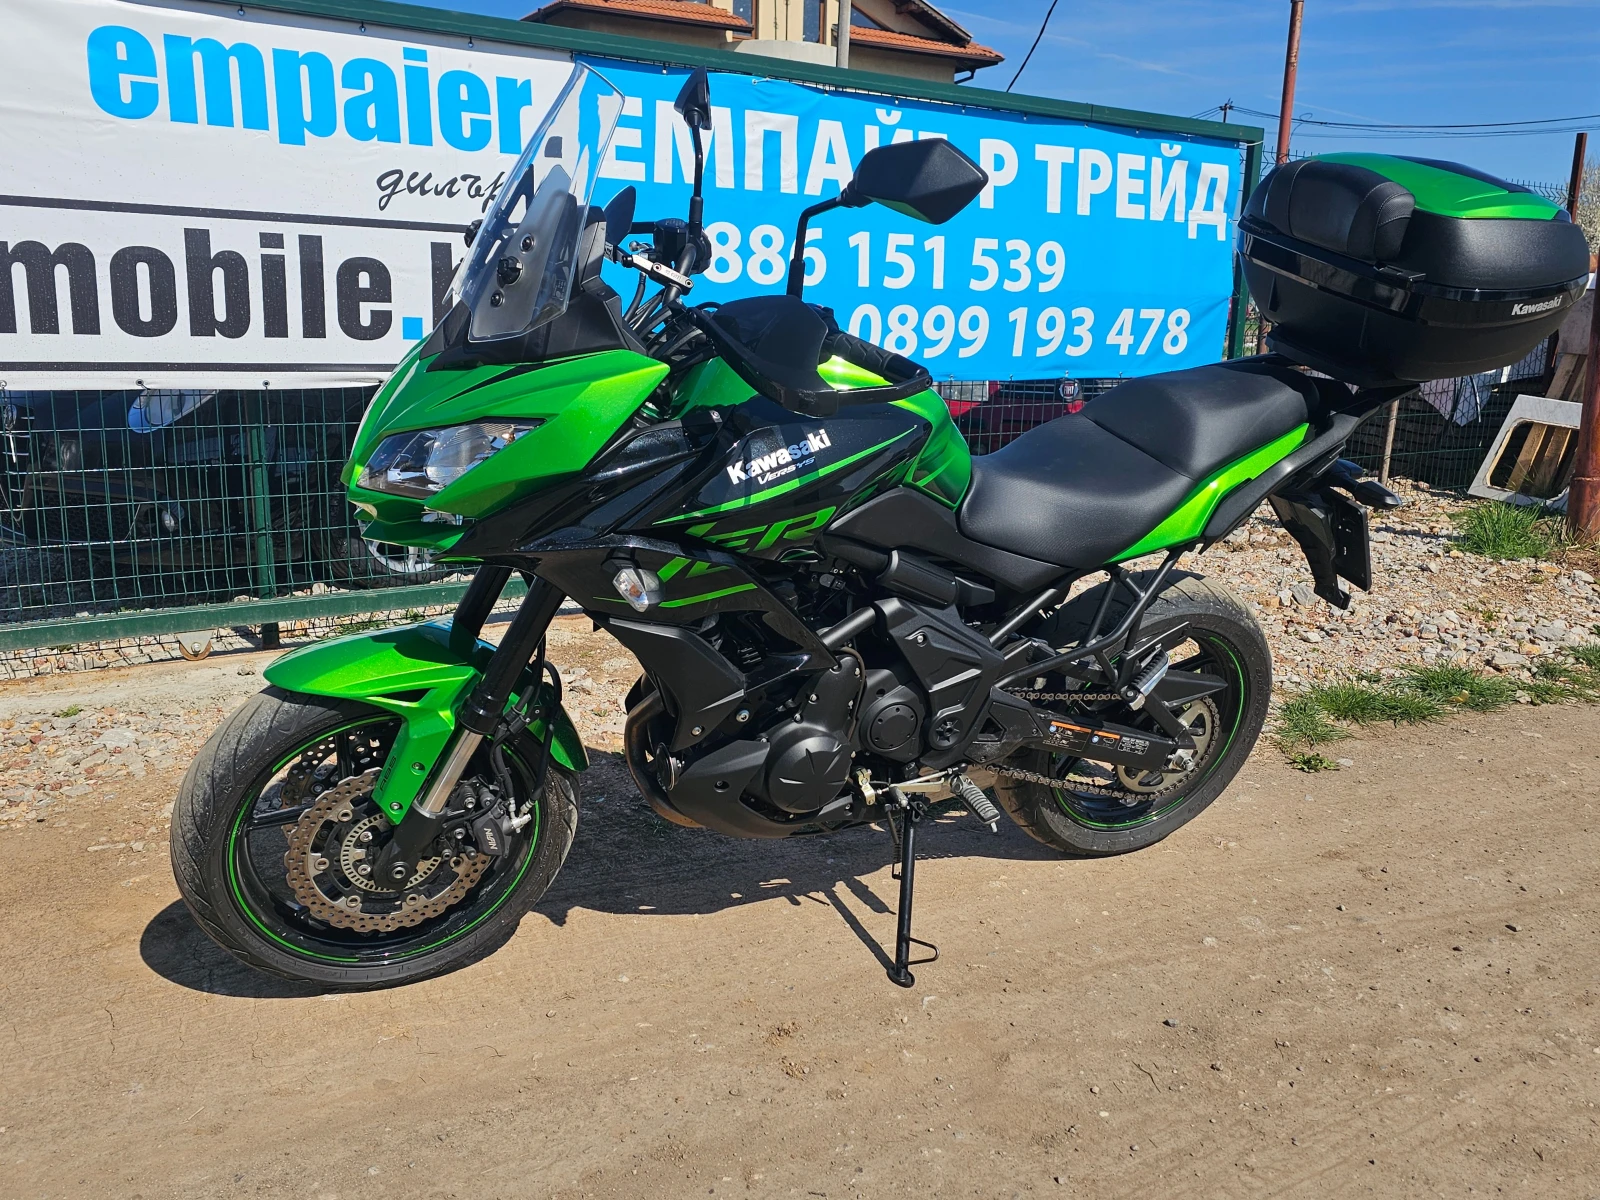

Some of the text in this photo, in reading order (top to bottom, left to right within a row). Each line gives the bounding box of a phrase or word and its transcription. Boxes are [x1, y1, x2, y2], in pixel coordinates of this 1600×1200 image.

[87, 25, 533, 156] empaier
[597, 93, 1231, 242] ЕМПАР ТРЕЙД
[848, 231, 946, 290] 151
[969, 238, 1066, 293] 539
[848, 303, 1191, 359] 0899 193 478
[1511, 295, 1563, 316] Kawasaki
[726, 428, 832, 485] Kawasaki
